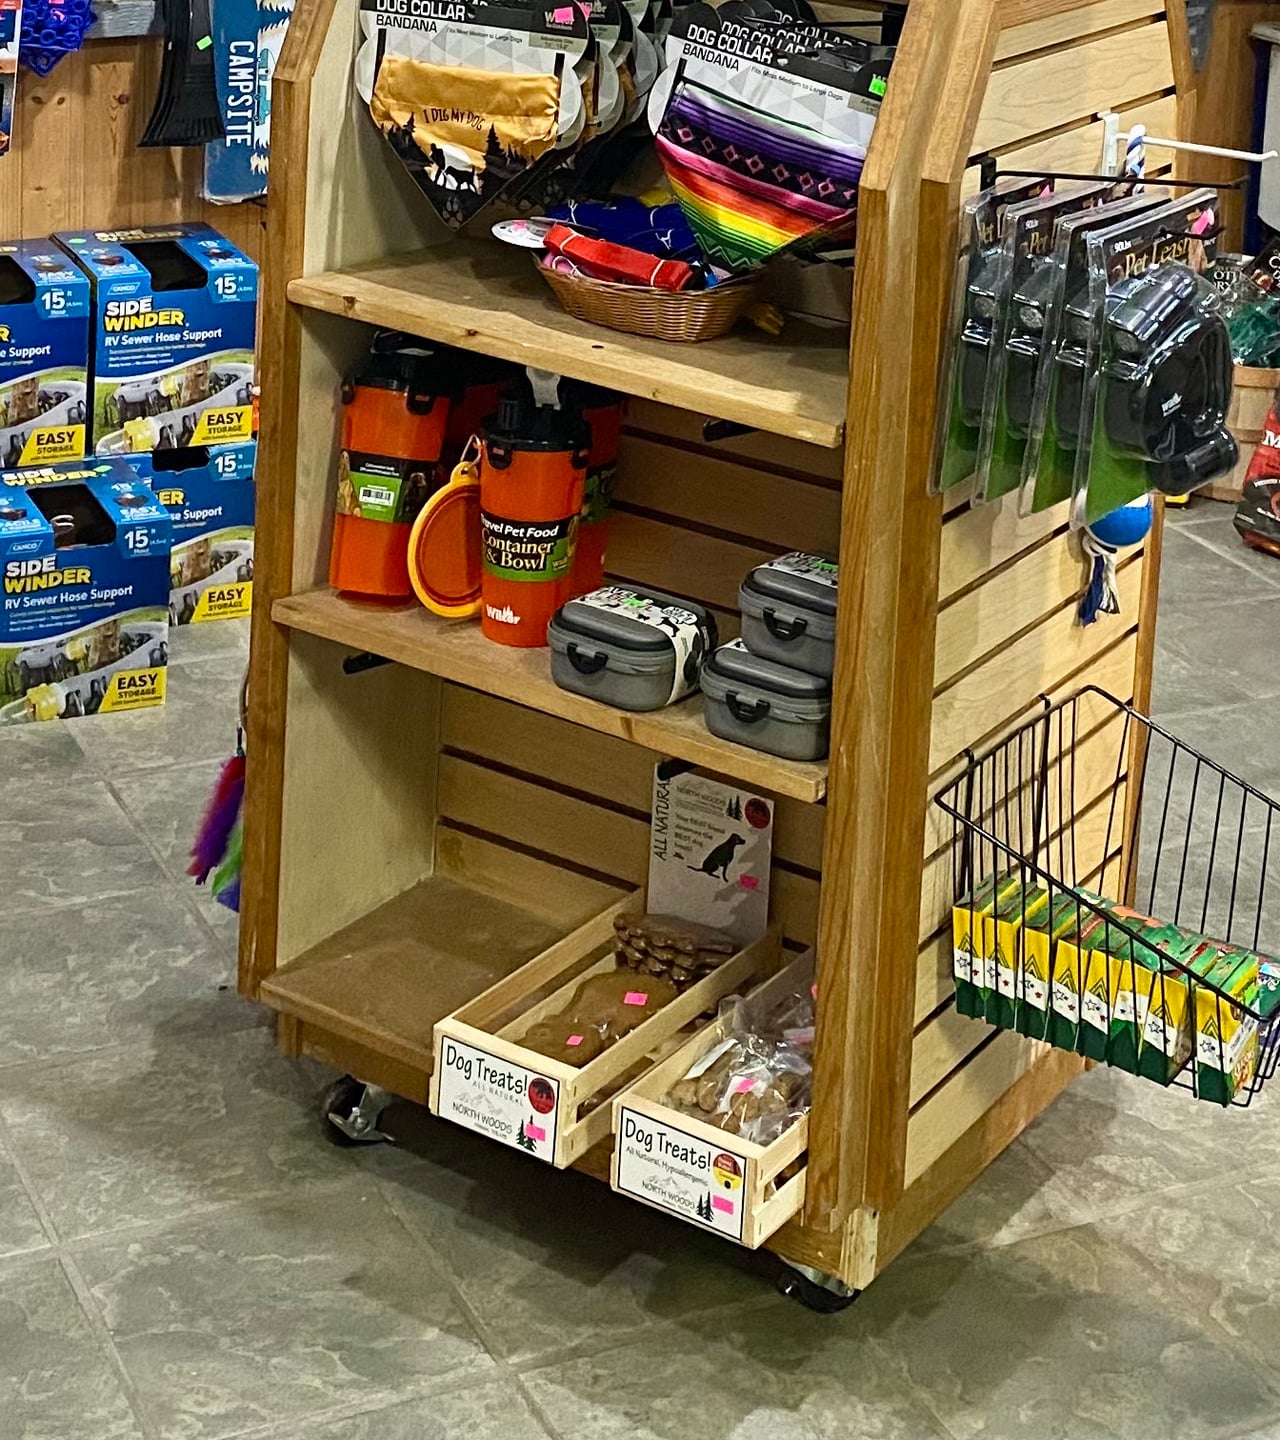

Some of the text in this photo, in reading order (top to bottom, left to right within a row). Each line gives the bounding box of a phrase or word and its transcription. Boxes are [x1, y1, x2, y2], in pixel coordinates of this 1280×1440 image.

[410, 0, 466, 21] COLLAR
[376, 14, 438, 34] BANDANA
[687, 24, 773, 64] DOG COLLAR
[682, 43, 739, 72] BANDANA
[225, 40, 255, 148] CAMPSITE
[431, 107, 464, 122] DIG MY
[214, 276, 237, 295] 15
[41, 291, 65, 310] 15
[106, 296, 153, 317] SIDE
[104, 310, 186, 332] WINDER
[104, 328, 222, 347] RV Sewer Hose Support
[9, 345, 51, 360] Support
[207, 412, 244, 427] EASY
[36, 431, 76, 446] EASY
[36, 444, 74, 455] STORAGE
[183, 506, 222, 520] Support
[124, 530, 149, 549] 15
[481, 527, 555, 555] Container
[504, 524, 560, 538] Pet Food
[6, 555, 57, 578] SIDE
[486, 548, 545, 570] & Bowl
[4, 566, 91, 594] WINDER
[5, 585, 133, 610] RV Sewer Hose Support
[208, 588, 245, 604] EASY
[117, 673, 158, 690] EASY
[118, 687, 157, 699] STORAGE
[654, 838, 667, 861] ALL
[446, 1044, 528, 1097] Dog Treats!
[625, 1118, 712, 1173] Dog Treats!
